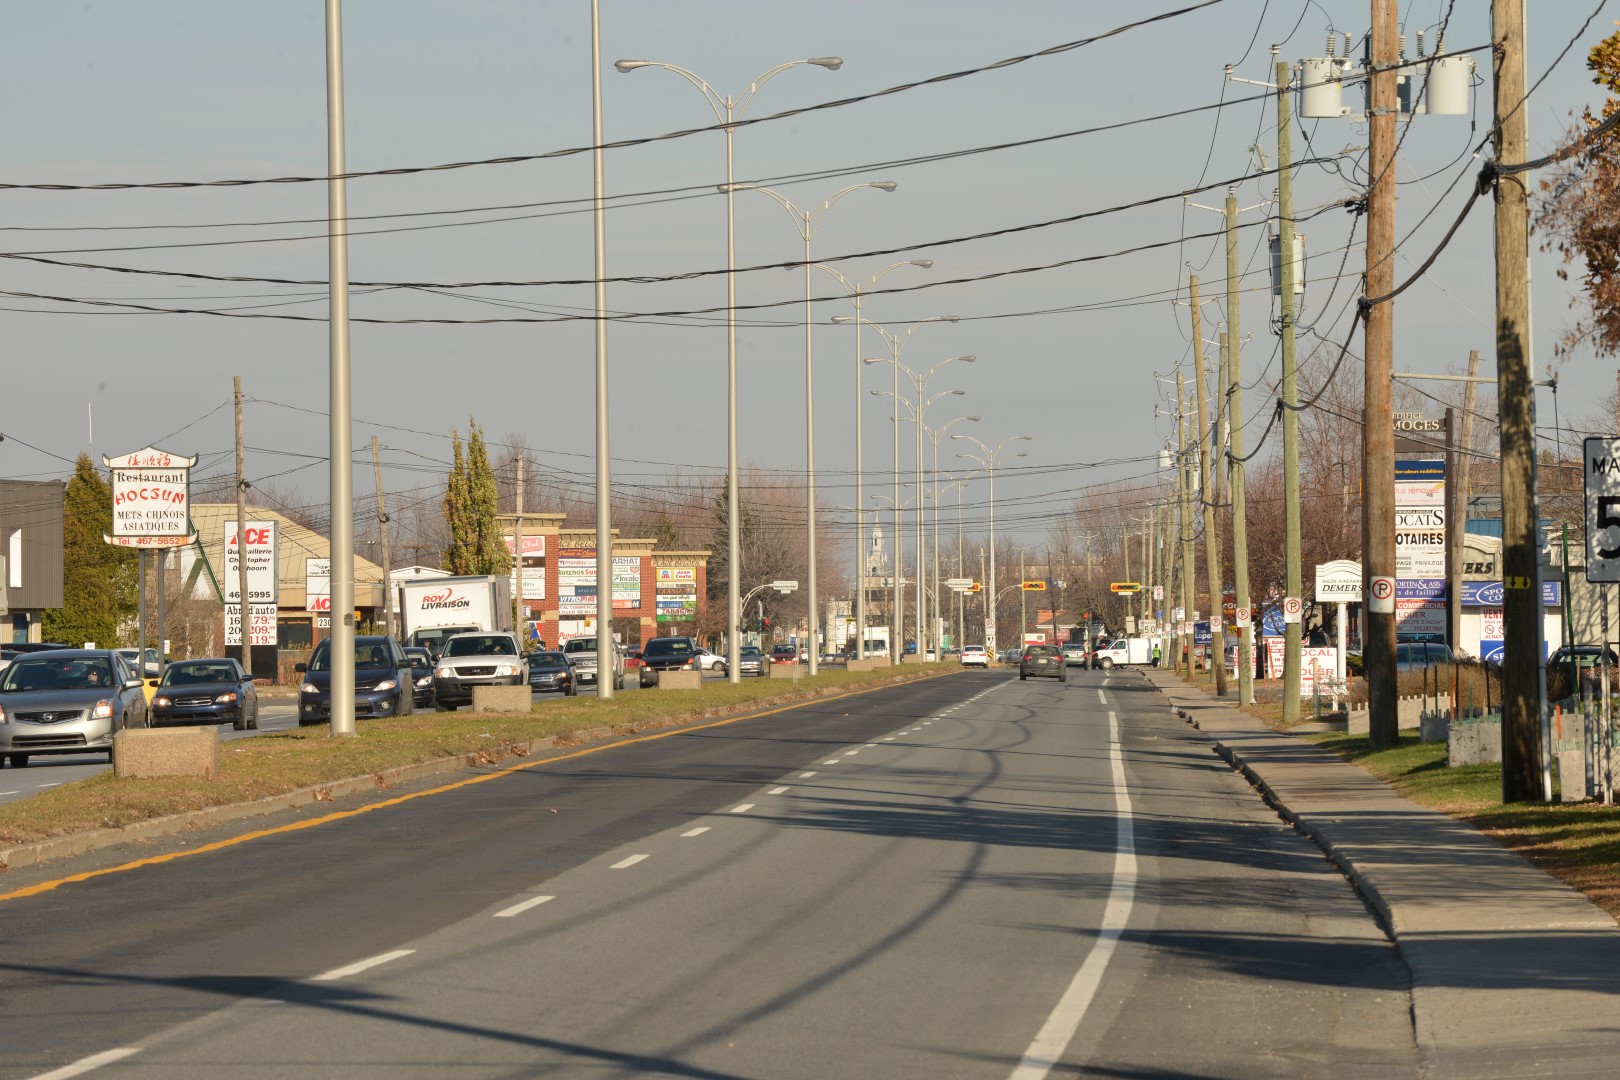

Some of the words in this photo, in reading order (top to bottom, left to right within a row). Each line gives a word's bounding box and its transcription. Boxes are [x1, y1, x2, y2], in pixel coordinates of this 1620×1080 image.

[1393, 420, 1439, 431] MOGES
[1592, 457, 1620, 474] MA
[117, 472, 184, 483] Restaurant
[115, 488, 185, 505] HOCSUN
[117, 511, 142, 520] METS
[146, 510, 185, 519] CHINOIS
[1395, 509, 1444, 526] OCATS
[122, 521, 179, 532] ASIATIQUES
[1597, 496, 1620, 560] 5
[117, 537, 132, 545] Tel.
[136, 537, 181, 545] 467-5652
[574, 540, 597, 548] BELO
[1395, 533, 1444, 545] OTAIRES
[1463, 562, 1493, 574] ERS
[1322, 584, 1362, 592] DEMERS
[1417, 579, 1429, 590] &
[228, 591, 271, 599] 465995
[1483, 588, 1504, 597] SPO
[422, 594, 445, 604] ROY
[1488, 594, 1504, 602] CO
[310, 597, 331, 611] AC
[421, 600, 470, 610] LIVRAISON
[226, 606, 242, 615] Abr
[1483, 609, 1503, 619] VENT
[229, 616, 241, 625] 16
[228, 626, 242, 635] 20
[1144, 626, 1156, 634] 50
[1301, 649, 1334, 657] OCAL
[1300, 668, 1335, 676] OUER
